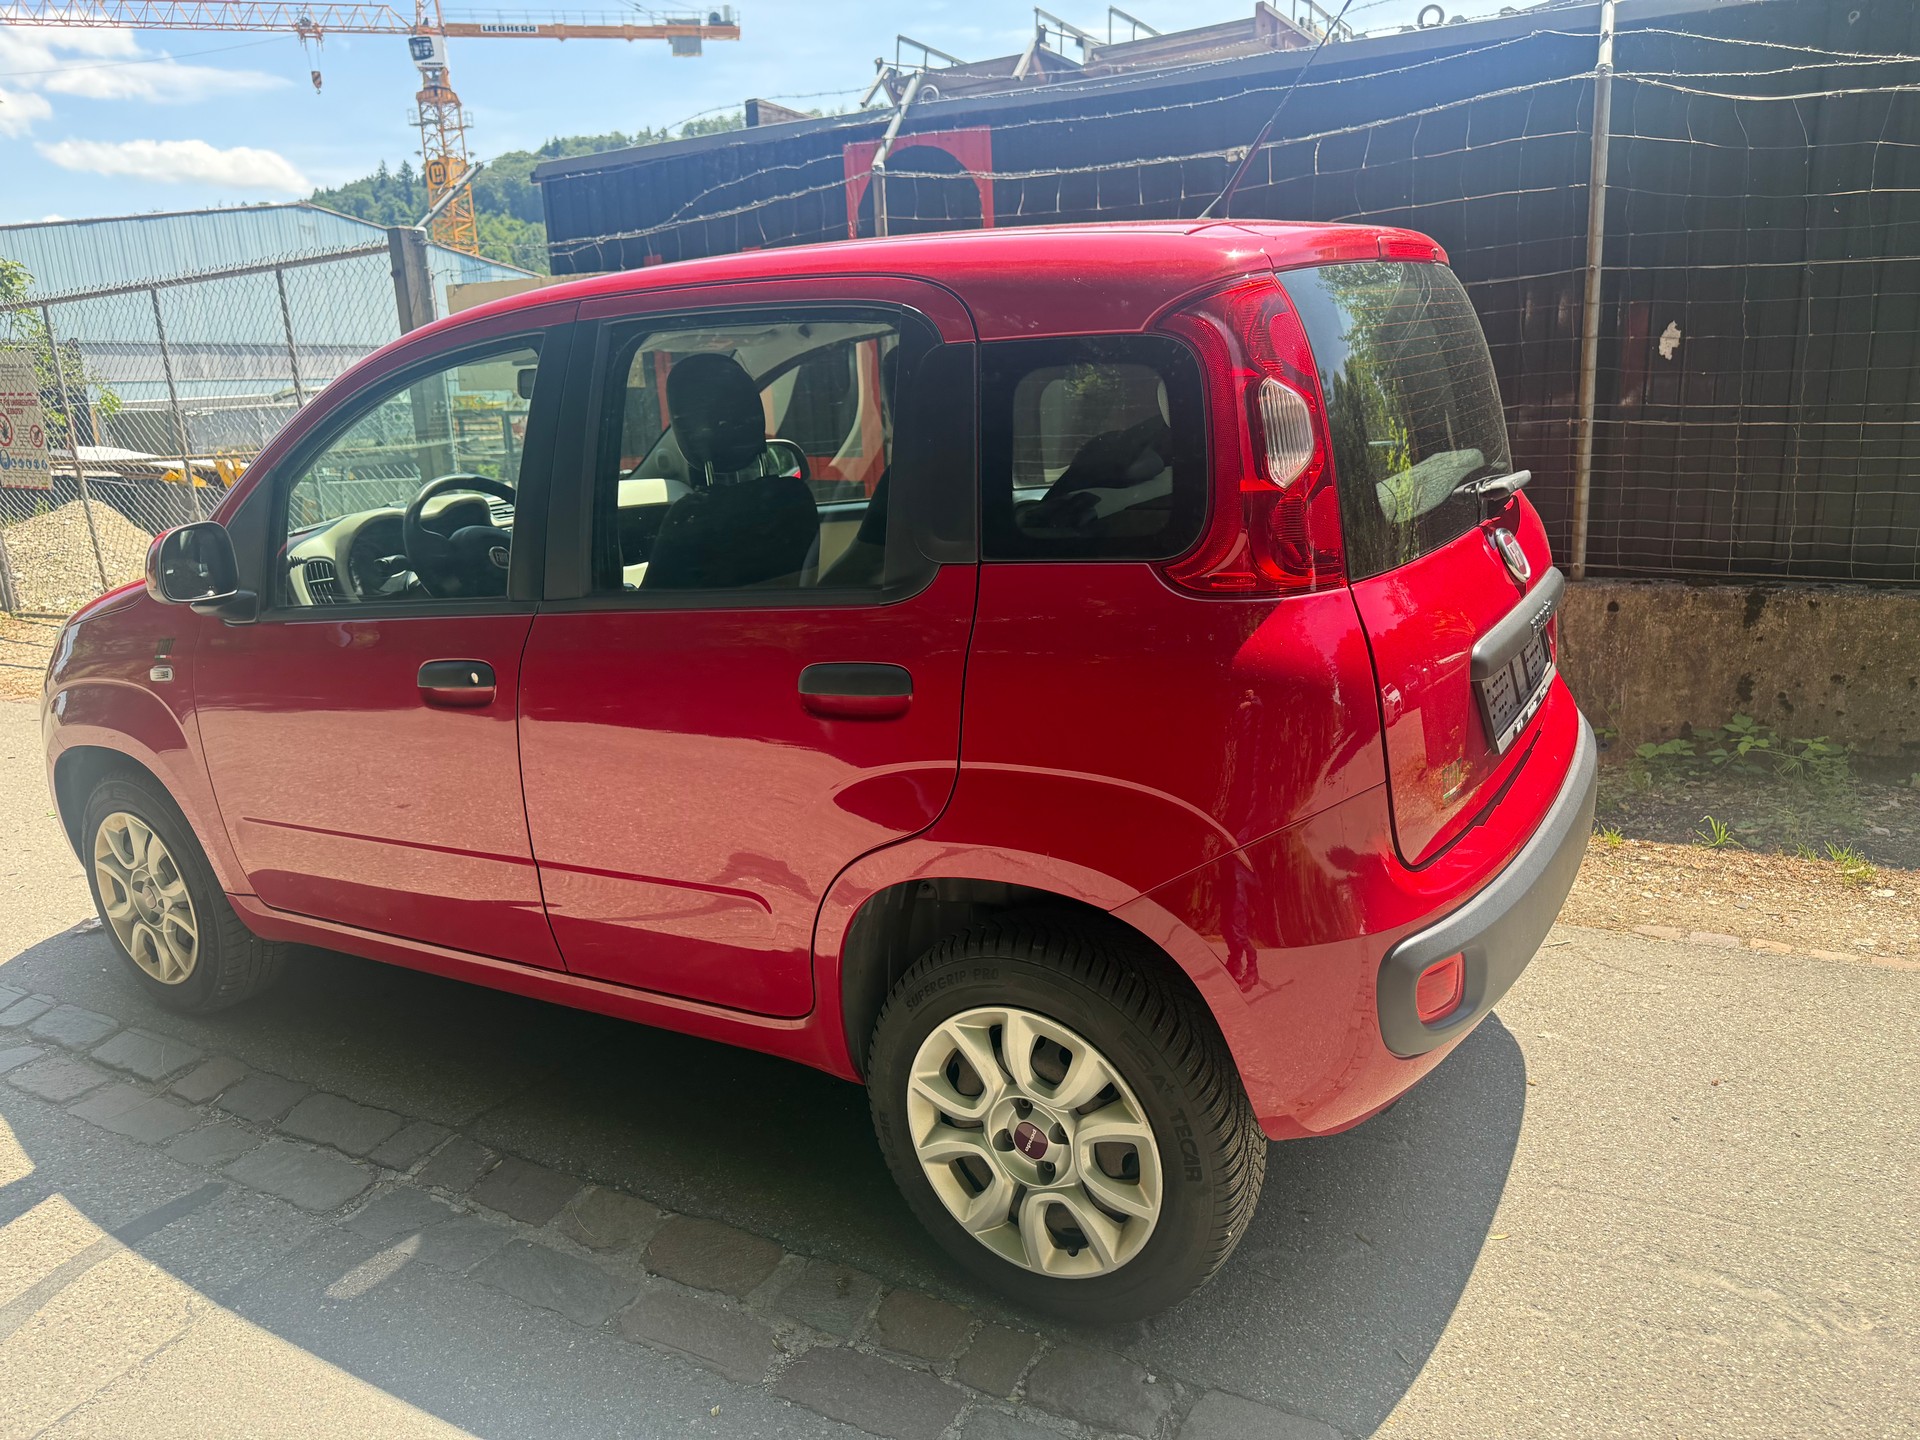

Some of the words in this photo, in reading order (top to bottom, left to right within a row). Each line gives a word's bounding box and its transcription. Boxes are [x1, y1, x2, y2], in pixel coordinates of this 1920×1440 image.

[482, 25, 536, 33] LIEBHERR
[906, 970, 966, 1012] SUPERGRIP
[973, 967, 999, 980] PRO
[1024, 1128, 1038, 1152] panda
[1168, 1107, 1203, 1183] TECAR
